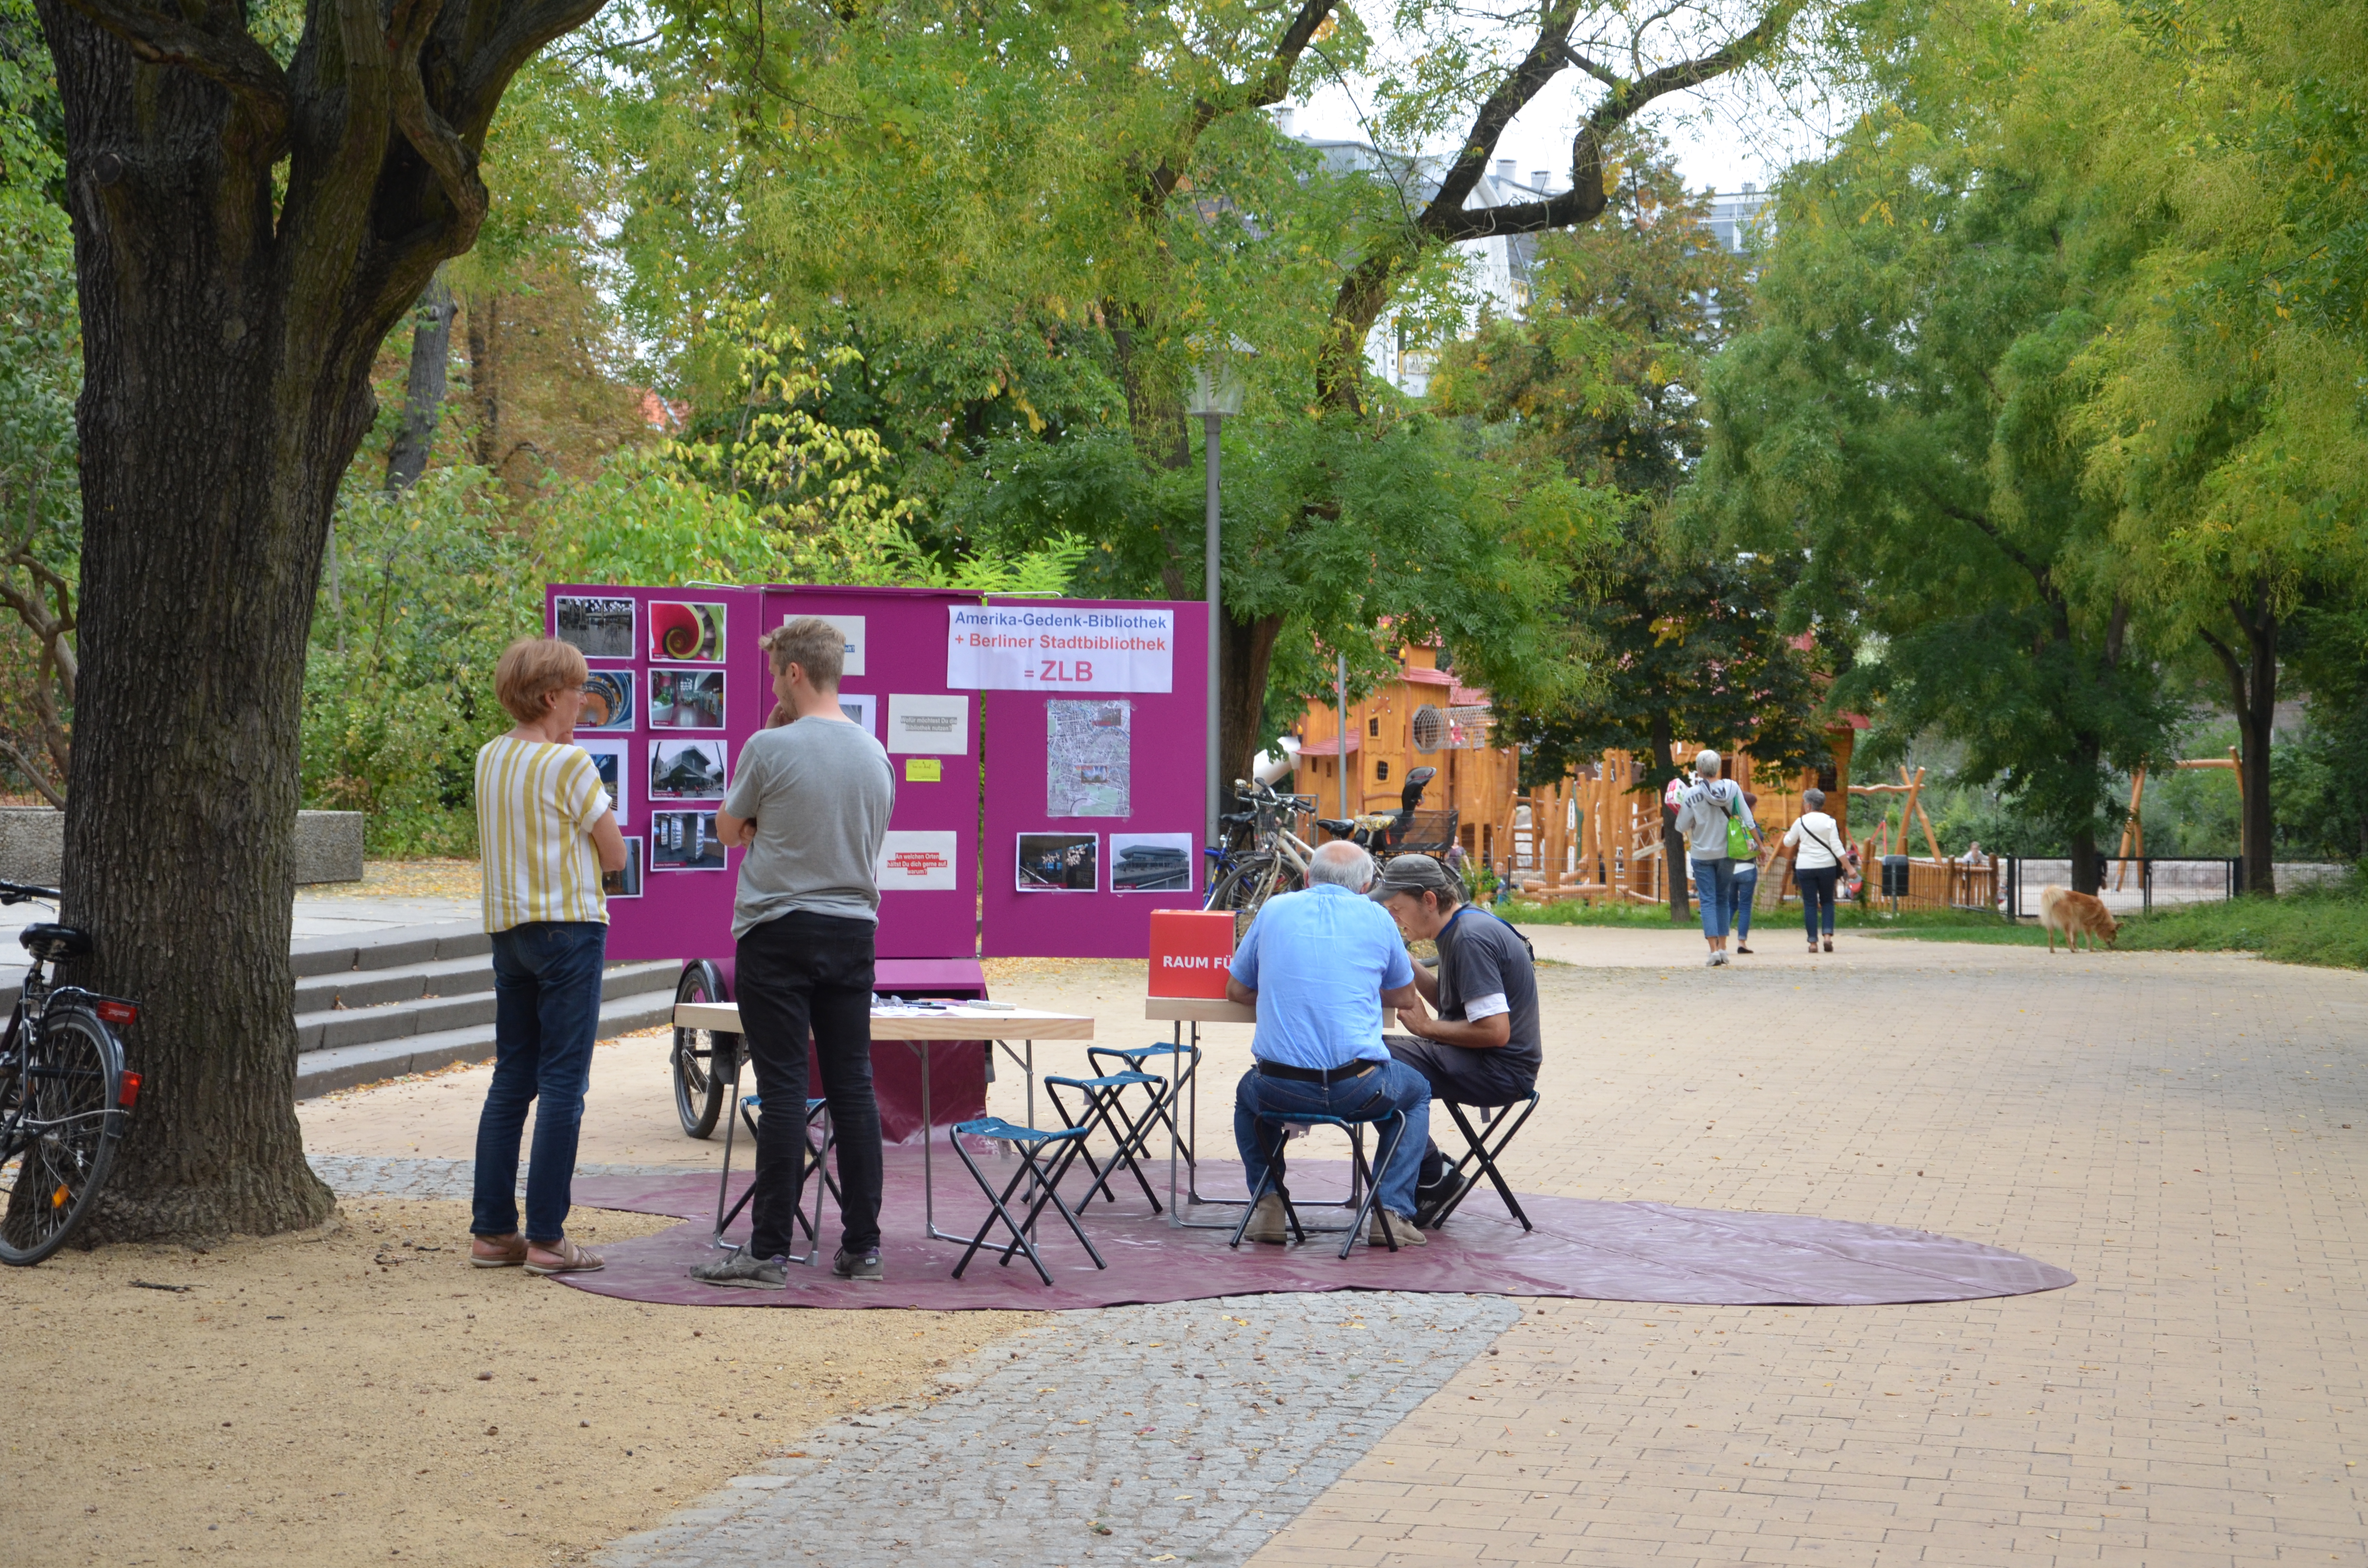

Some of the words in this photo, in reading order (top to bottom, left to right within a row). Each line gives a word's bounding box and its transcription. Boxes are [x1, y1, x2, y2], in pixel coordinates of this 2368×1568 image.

[955, 611, 1167, 628] Amerika-Gedenk-Bibliothek
[970, 633, 1034, 648] Berliner
[1040, 635, 1166, 650] Stadtbibliothek
[1040, 660, 1093, 682] ZLB
[1163, 955, 1209, 969] RAUM
